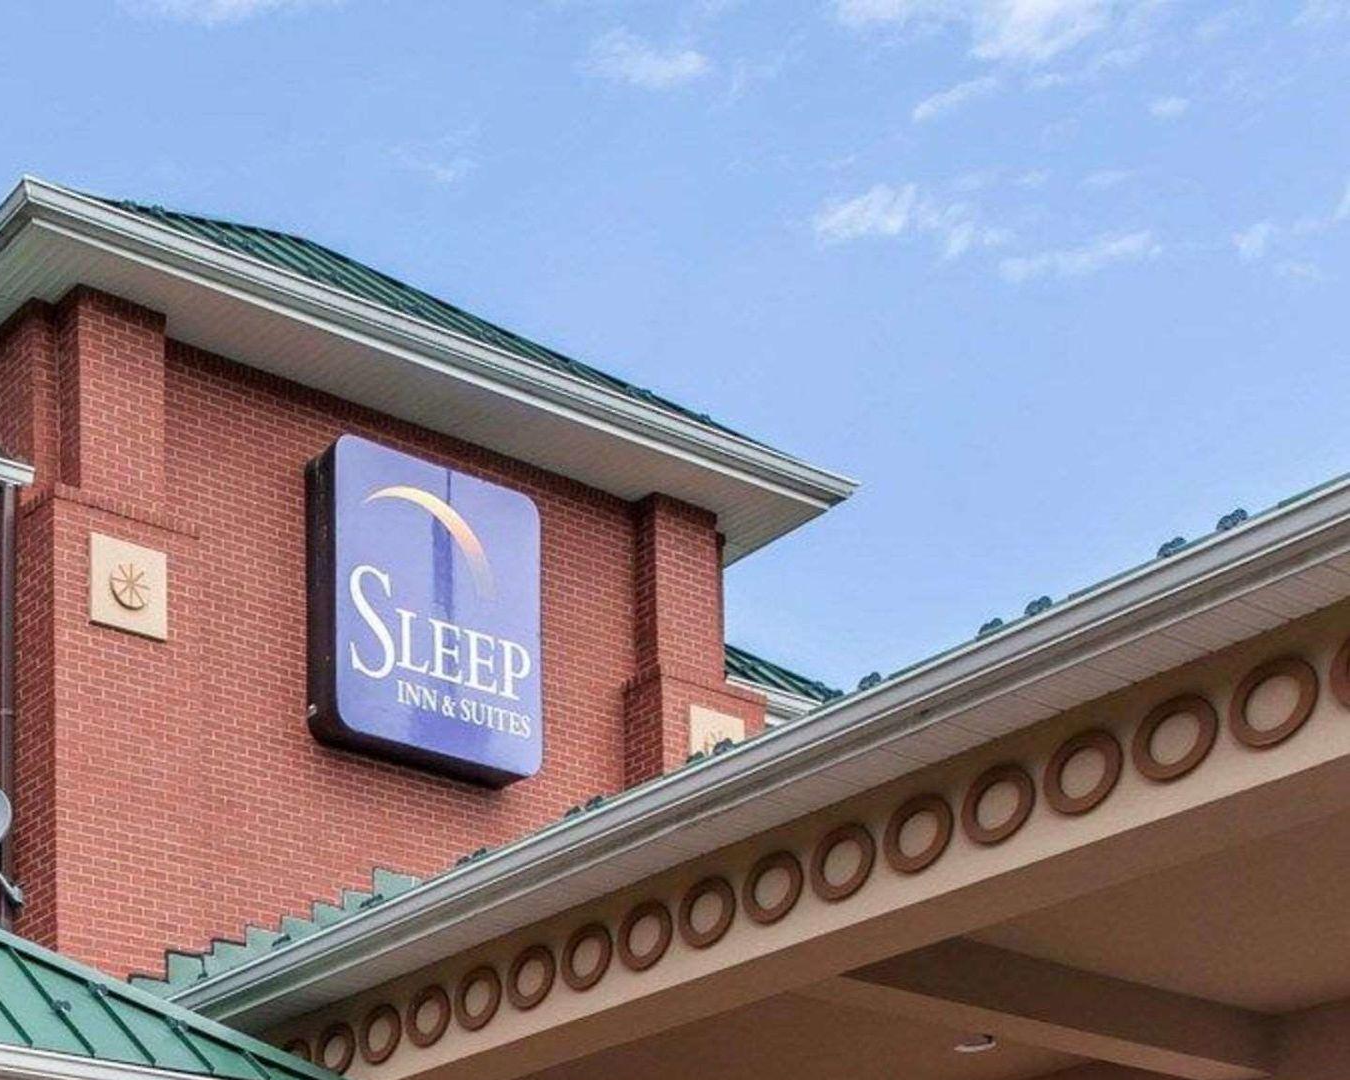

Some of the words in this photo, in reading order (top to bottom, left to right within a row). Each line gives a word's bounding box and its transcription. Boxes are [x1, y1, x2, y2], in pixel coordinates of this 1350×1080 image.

[349, 565, 532, 700] SLEEP
[396, 679, 437, 712] INN
[441, 695, 456, 718] &
[460, 698, 532, 740] SUITES
